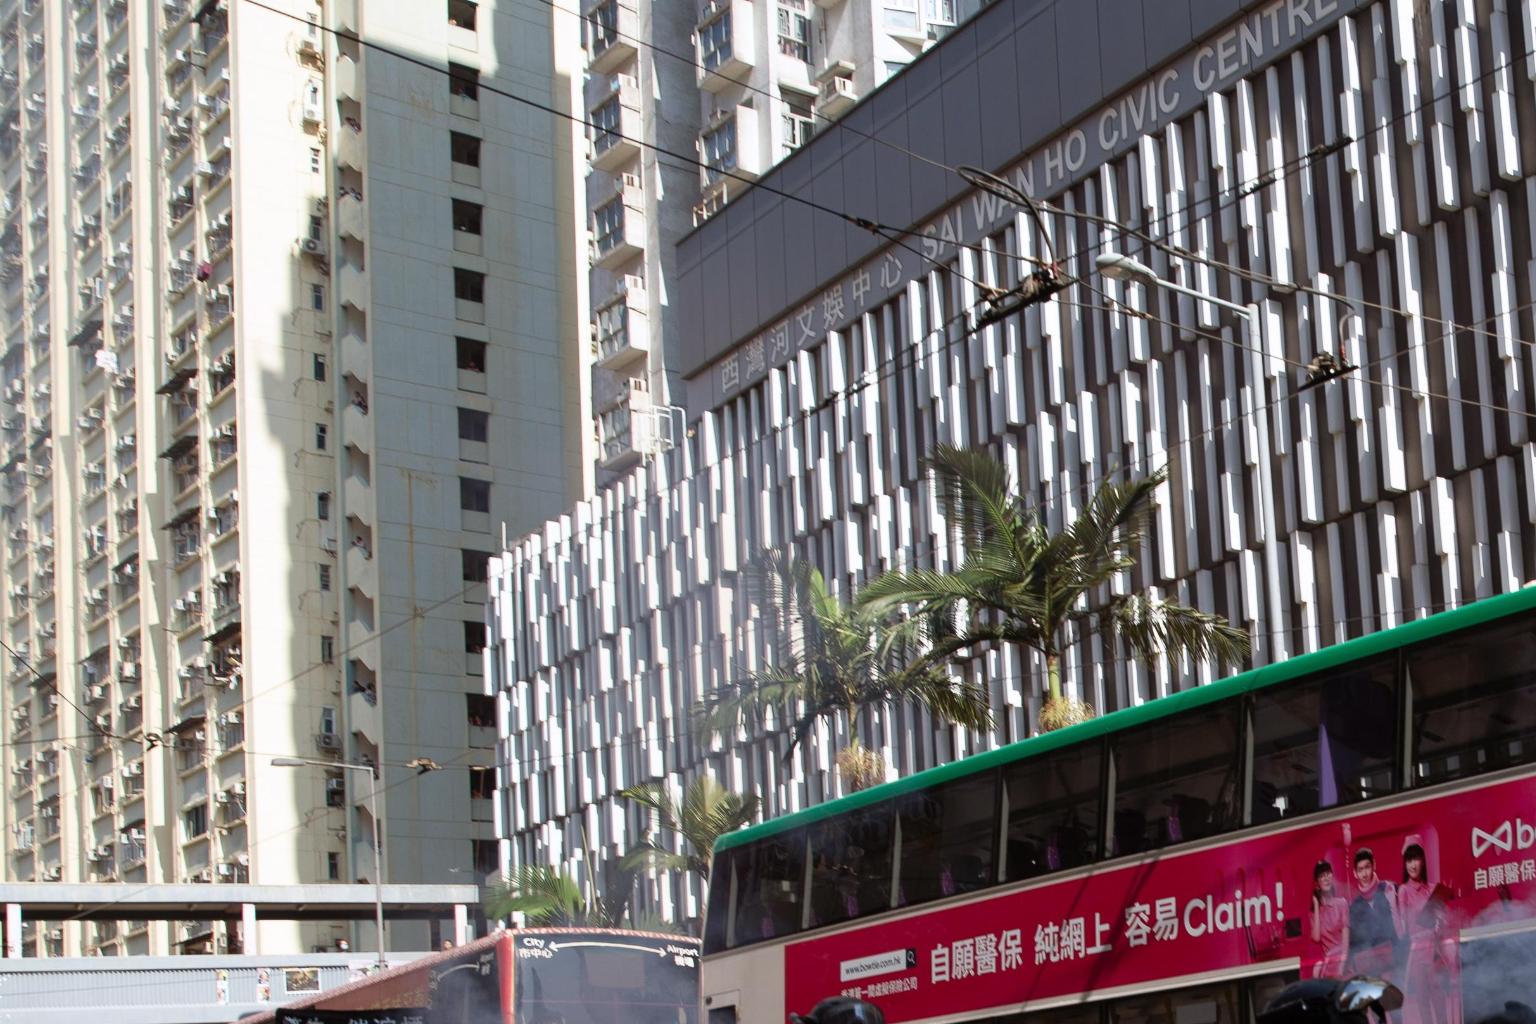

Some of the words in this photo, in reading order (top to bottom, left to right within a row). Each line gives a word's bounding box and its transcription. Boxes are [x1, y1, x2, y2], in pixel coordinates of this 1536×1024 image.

[921, 203, 964, 263] SAI
[1044, 129, 1088, 189] HO
[1098, 68, 1181, 151] CIVIC
[721, 253, 903, 393] 西灣河文娛中心
[930, 928, 1023, 985] 自願醫保
[1034, 911, 1113, 966] 純網上
[1124, 896, 1178, 947] 容易
[1183, 881, 1286, 939] Claim!
[1473, 855, 1536, 891] 自願醫保
